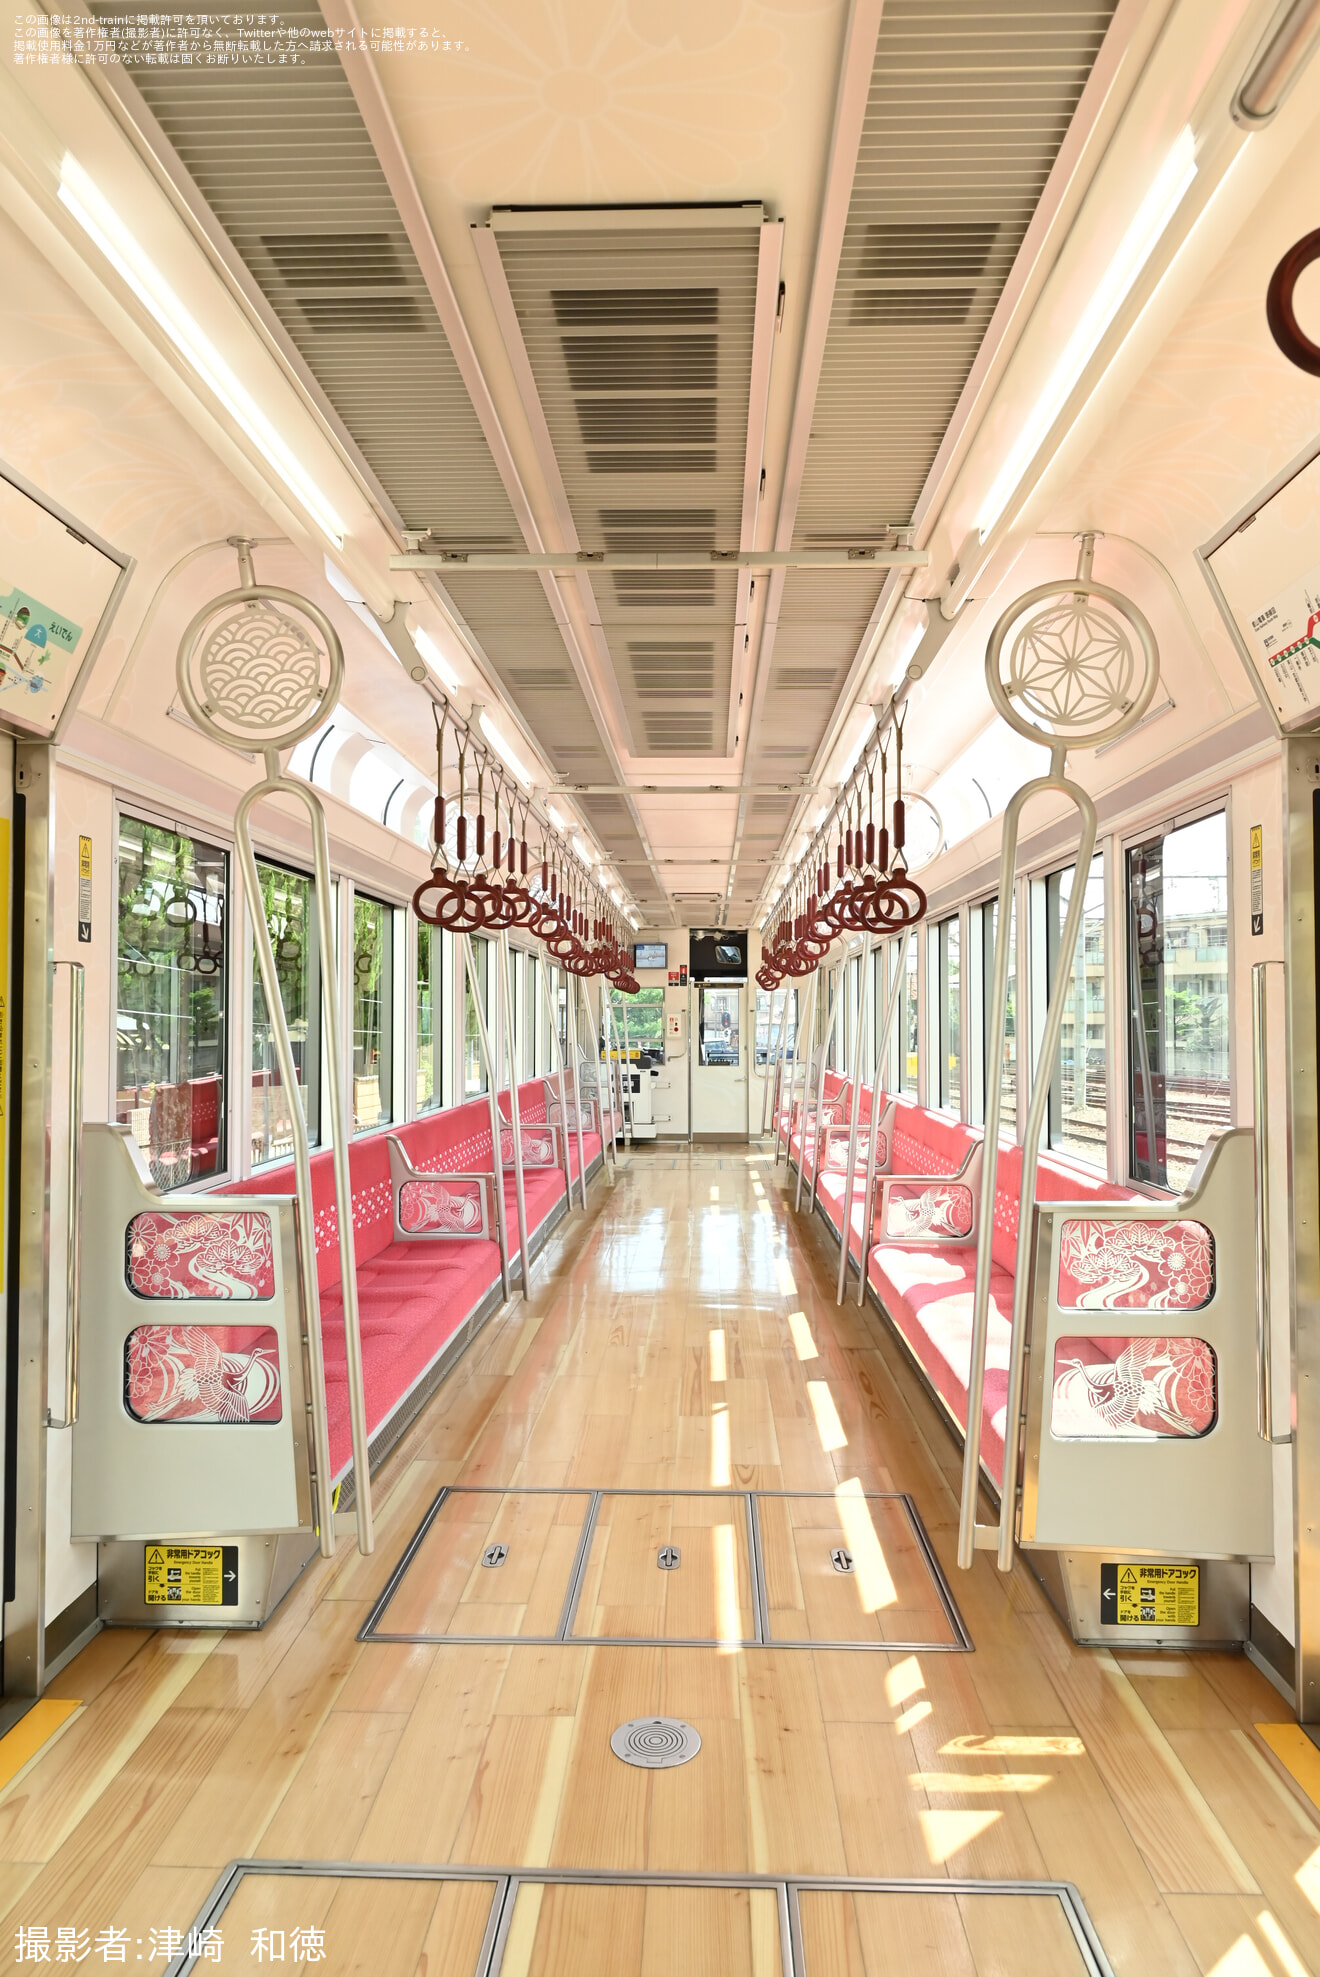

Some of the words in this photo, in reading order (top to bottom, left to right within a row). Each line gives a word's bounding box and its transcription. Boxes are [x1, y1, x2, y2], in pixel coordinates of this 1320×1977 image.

[49, 621, 73, 642] えいでん
[167, 1549, 220, 1559] 非常用ドアコック
[1140, 1568, 1196, 1579] 非常用ドアコック
